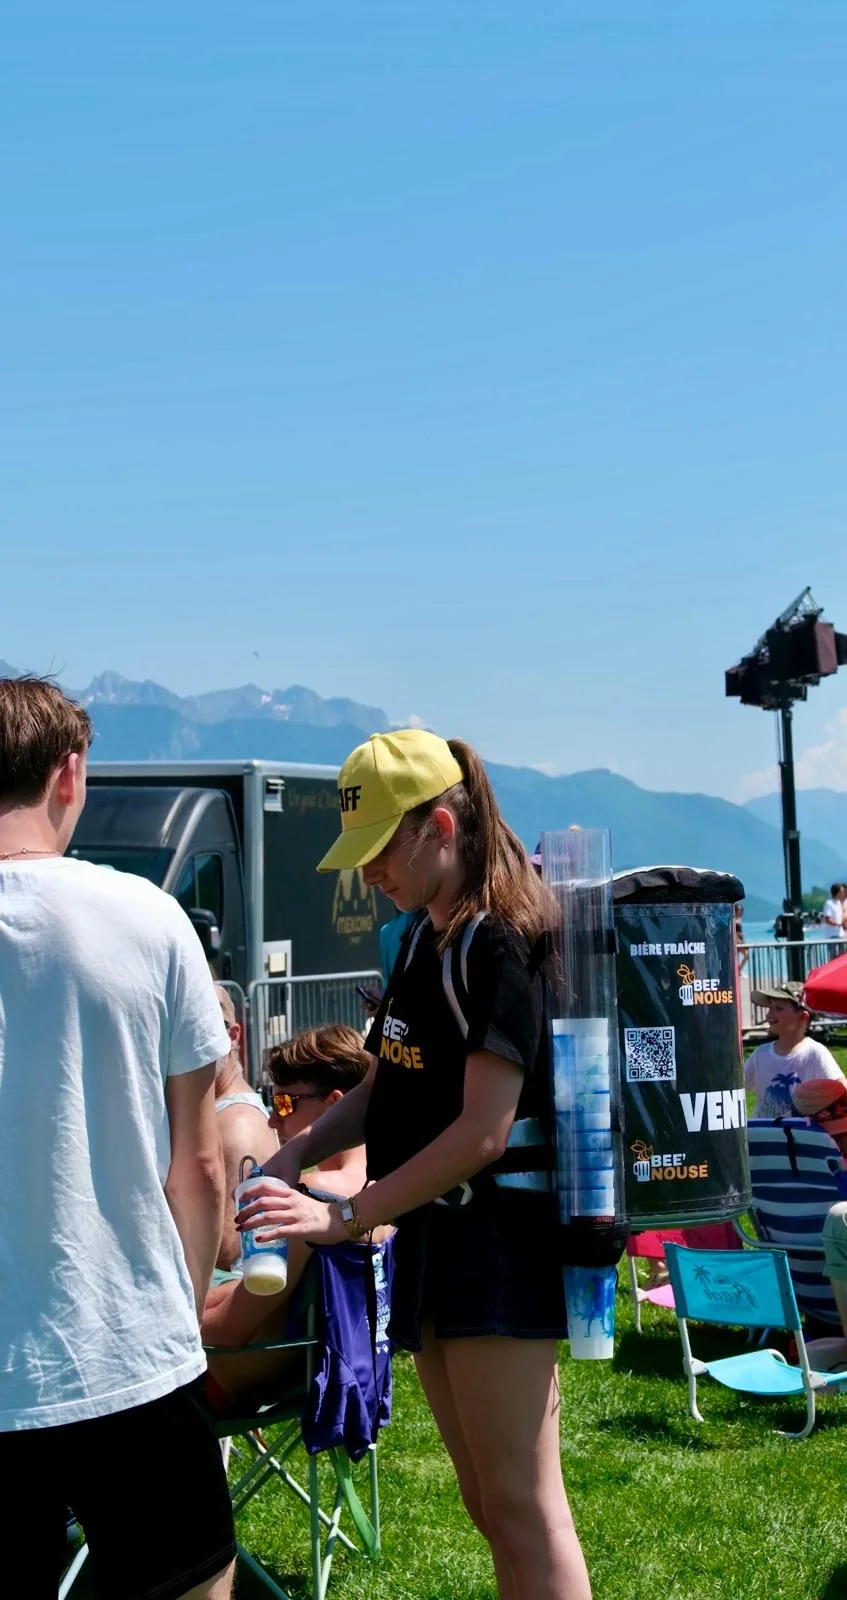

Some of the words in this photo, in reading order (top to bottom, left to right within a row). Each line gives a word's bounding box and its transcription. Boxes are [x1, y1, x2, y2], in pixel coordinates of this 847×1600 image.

[630, 941, 662, 956] BIÈRE
[664, 940, 706, 955] FRAÎCHE
[694, 991, 733, 1005] NOUSE
[379, 1036, 424, 1069] NOSE
[651, 1153, 686, 1168] BEE'
[651, 1164, 709, 1181] NOUSE
